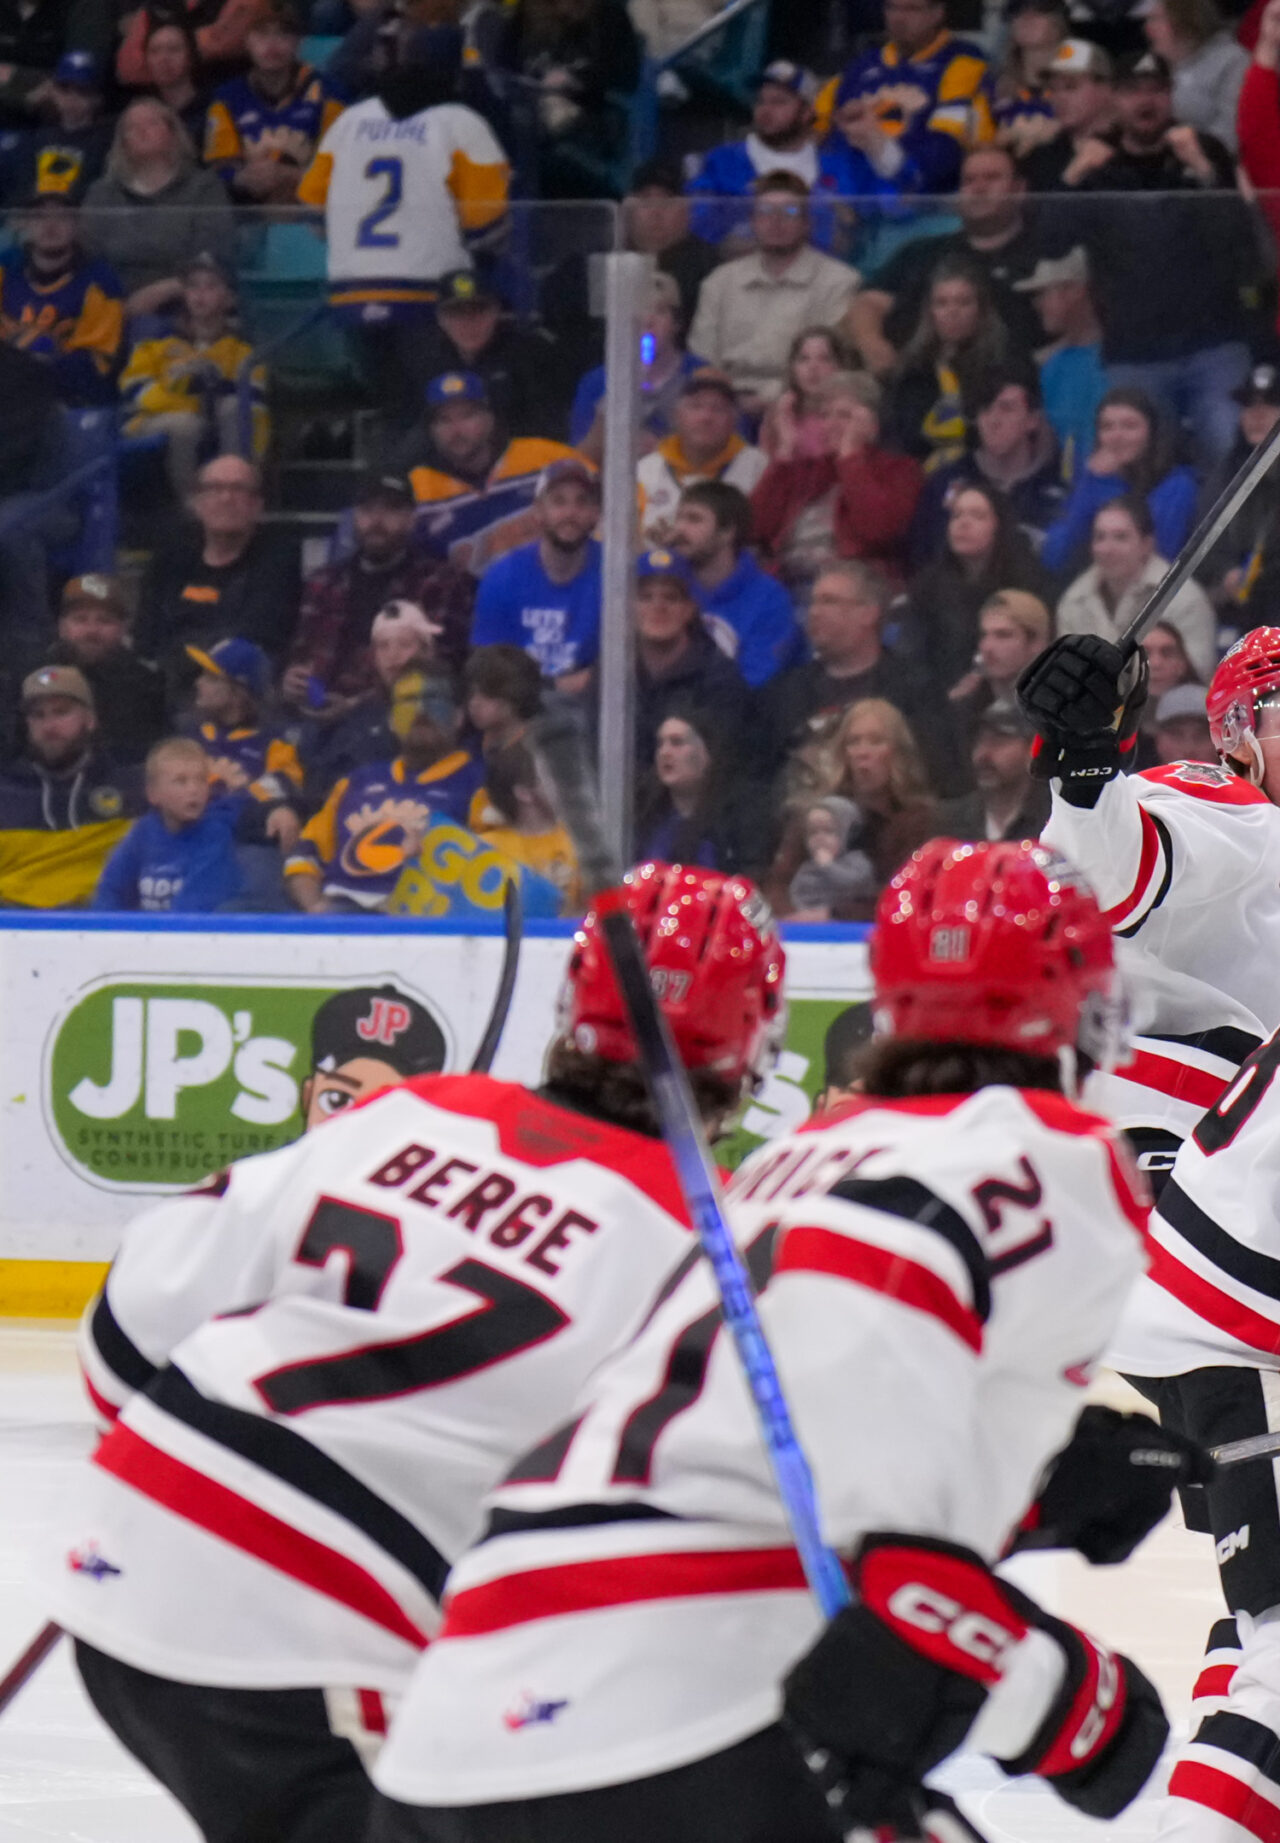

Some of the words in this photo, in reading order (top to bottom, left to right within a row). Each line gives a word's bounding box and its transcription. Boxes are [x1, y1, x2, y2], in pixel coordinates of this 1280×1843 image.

[364, 156, 403, 248] 2
[421, 825, 516, 911] GO
[68, 996, 299, 1125] JP's
[356, 997, 411, 1045] JP
[78, 1129, 205, 1149] SYNTHETIC
[92, 1149, 232, 1169] CONSTRUCT
[367, 1143, 600, 1277] BERGE
[969, 1155, 1055, 1277] 21
[1216, 1523, 1250, 1566] CM
[886, 1581, 1018, 1671] CC
